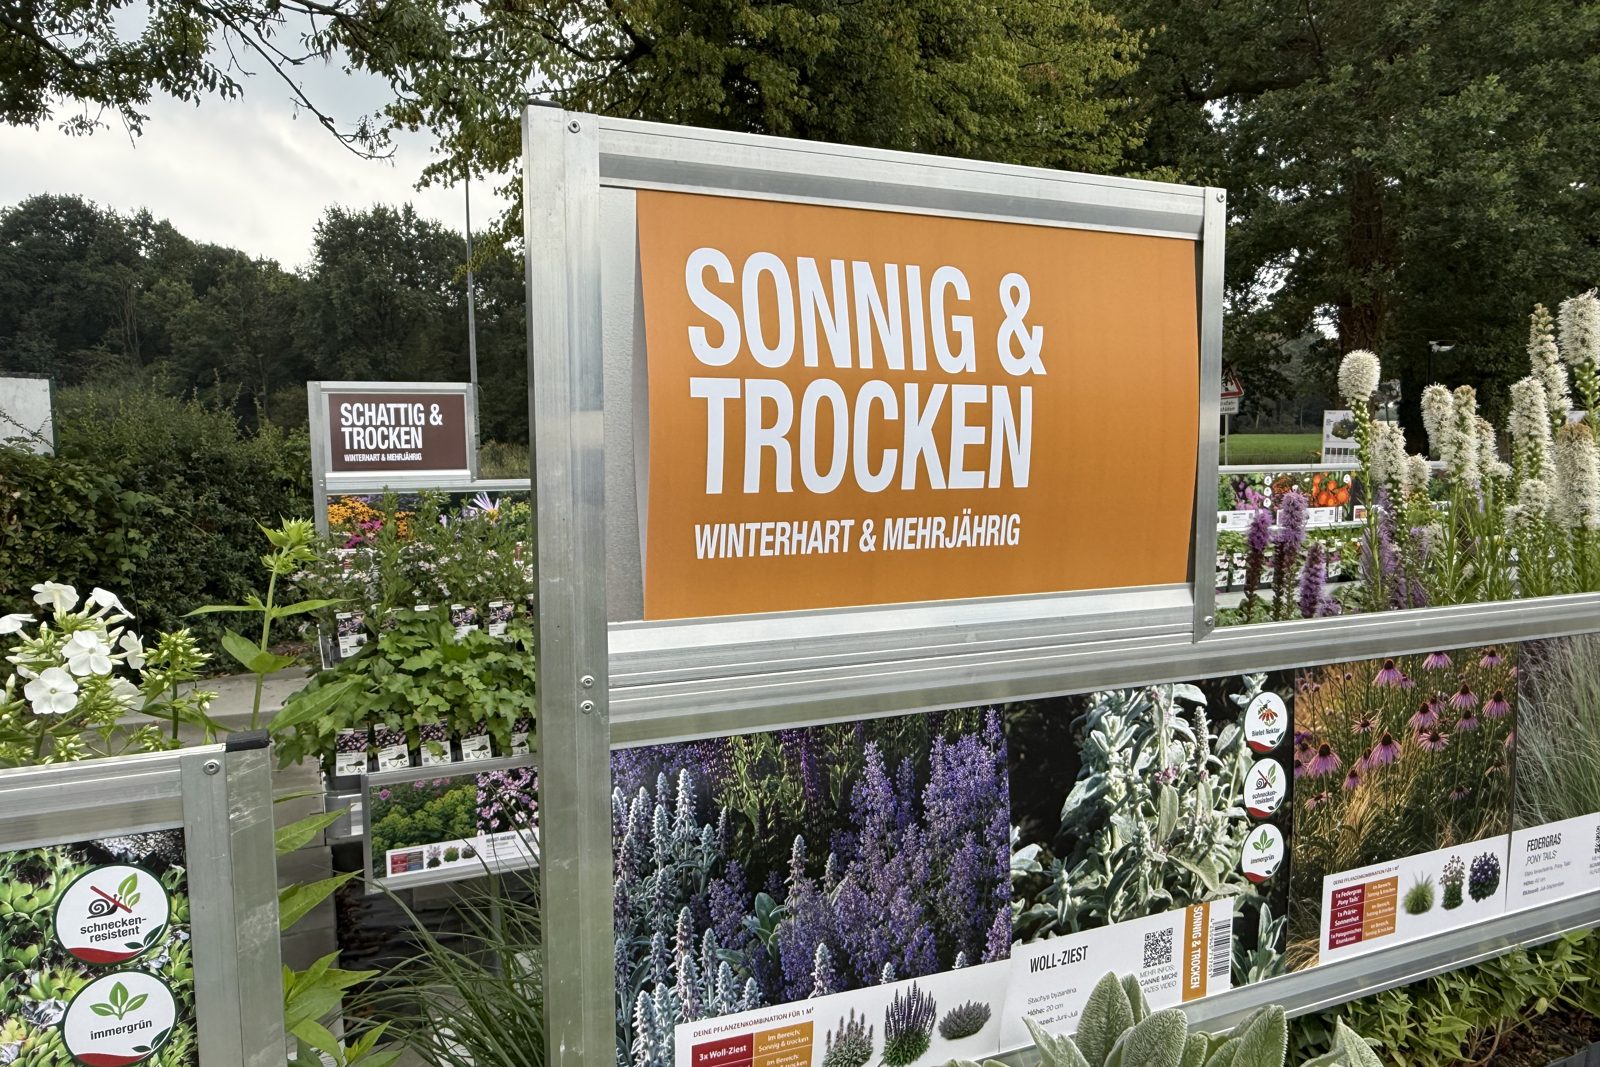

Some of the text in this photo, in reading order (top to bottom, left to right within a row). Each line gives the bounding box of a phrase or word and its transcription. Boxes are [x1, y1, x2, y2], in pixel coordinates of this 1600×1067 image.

[685, 247, 1048, 376] SONNIG &
[340, 403, 443, 426] SCHATTIG &
[341, 426, 423, 450] TROCKEN
[689, 377, 1033, 494] TROCKEN
[344, 452, 422, 462] WINTERHART & MEHRJÄHRIG
[694, 508, 1021, 560] WINTERHART & MEHRJÄHRIG
[1526, 832, 1562, 853] FEDERGRAS
[80, 916, 147, 935] schnecken-
[1191, 905, 1204, 939] SONNIG
[89, 925, 140, 943] resistent
[1030, 945, 1089, 974] WOLL-ZIEST
[1190, 947, 1202, 989] TROCKEN
[90, 1018, 153, 1041] immergrün
[693, 1028, 712, 1038] DEINE
[713, 1014, 788, 1034] PFLANZENKOMBINATION
[788, 1010, 801, 1019] FÜR
[699, 1045, 747, 1061] 3x Woll-Ziest
[758, 1042, 780, 1053] Sonnig
[786, 1036, 809, 1047] trocken
